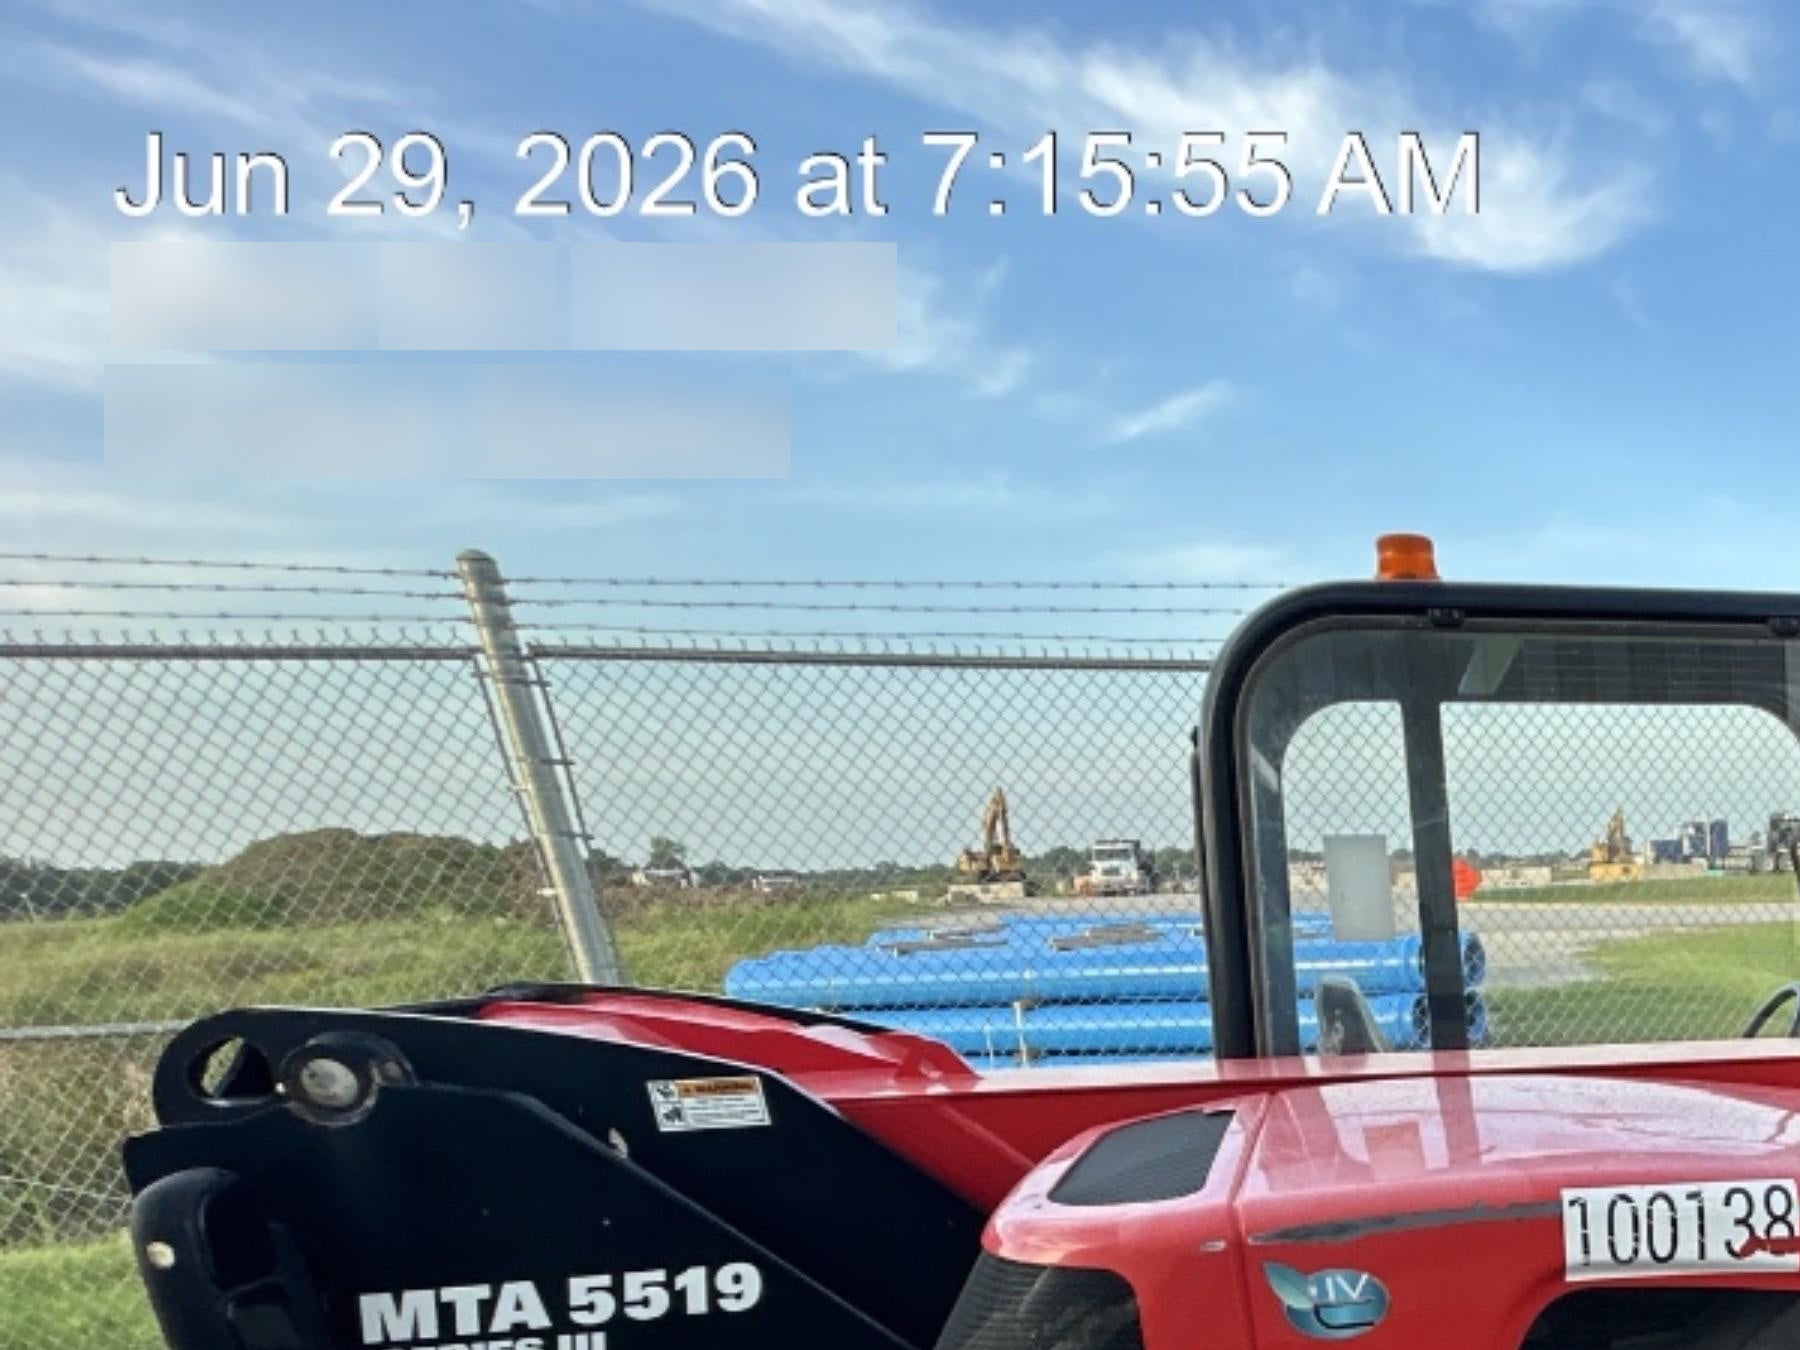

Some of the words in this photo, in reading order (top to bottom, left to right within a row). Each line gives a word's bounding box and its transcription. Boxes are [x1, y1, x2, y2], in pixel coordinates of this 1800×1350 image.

[1568, 1184, 1797, 1267] 100138
[359, 1279, 553, 1345] MTA
[567, 1261, 764, 1326] 5519
